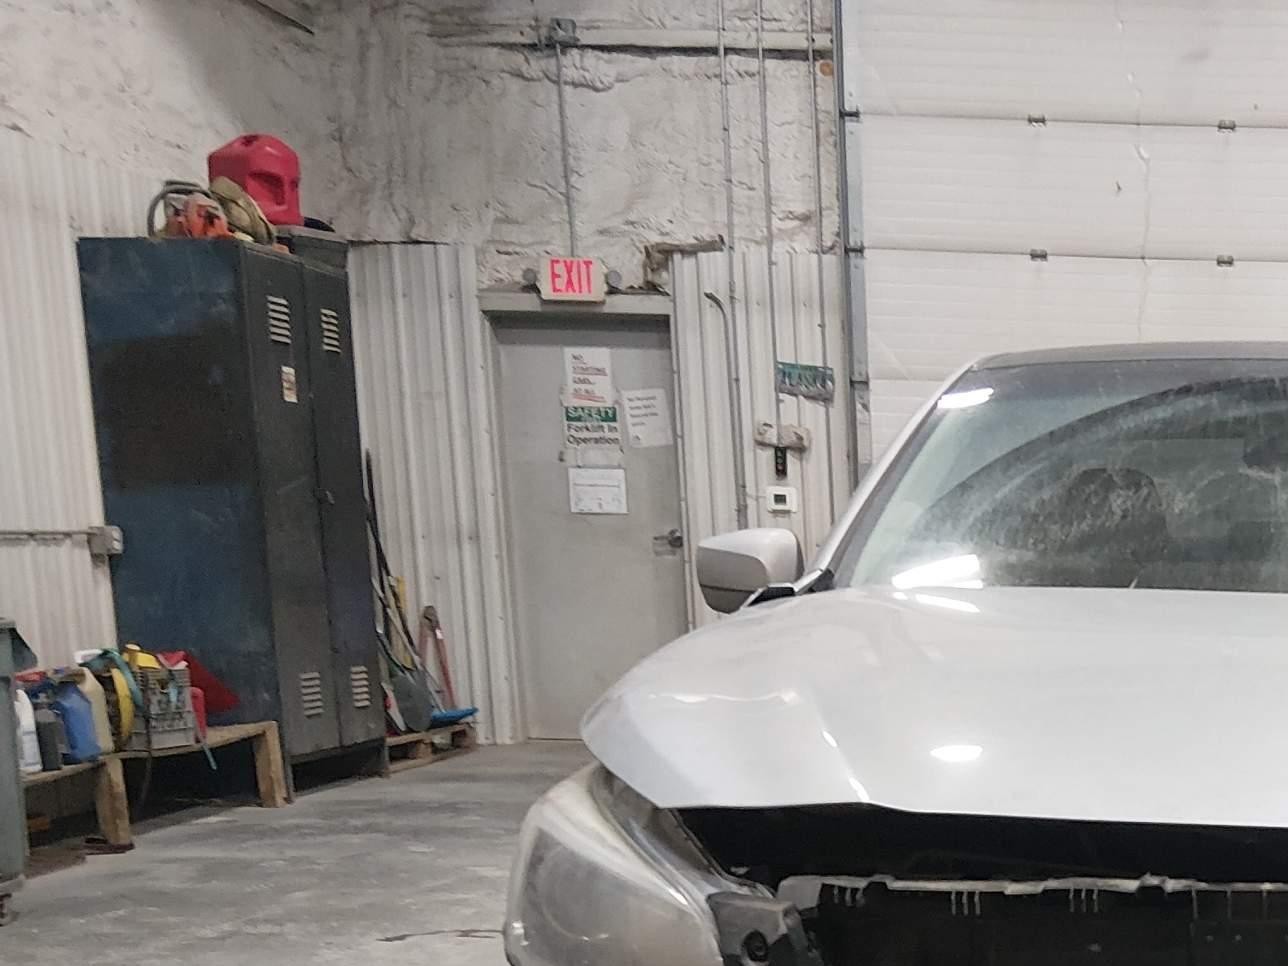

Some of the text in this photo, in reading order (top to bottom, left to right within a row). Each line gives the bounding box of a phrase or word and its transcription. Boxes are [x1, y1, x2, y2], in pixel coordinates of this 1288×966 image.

[550, 259, 593, 294] EXIT
[567, 407, 615, 418] SAFETY
[567, 434, 620, 446] Operation
